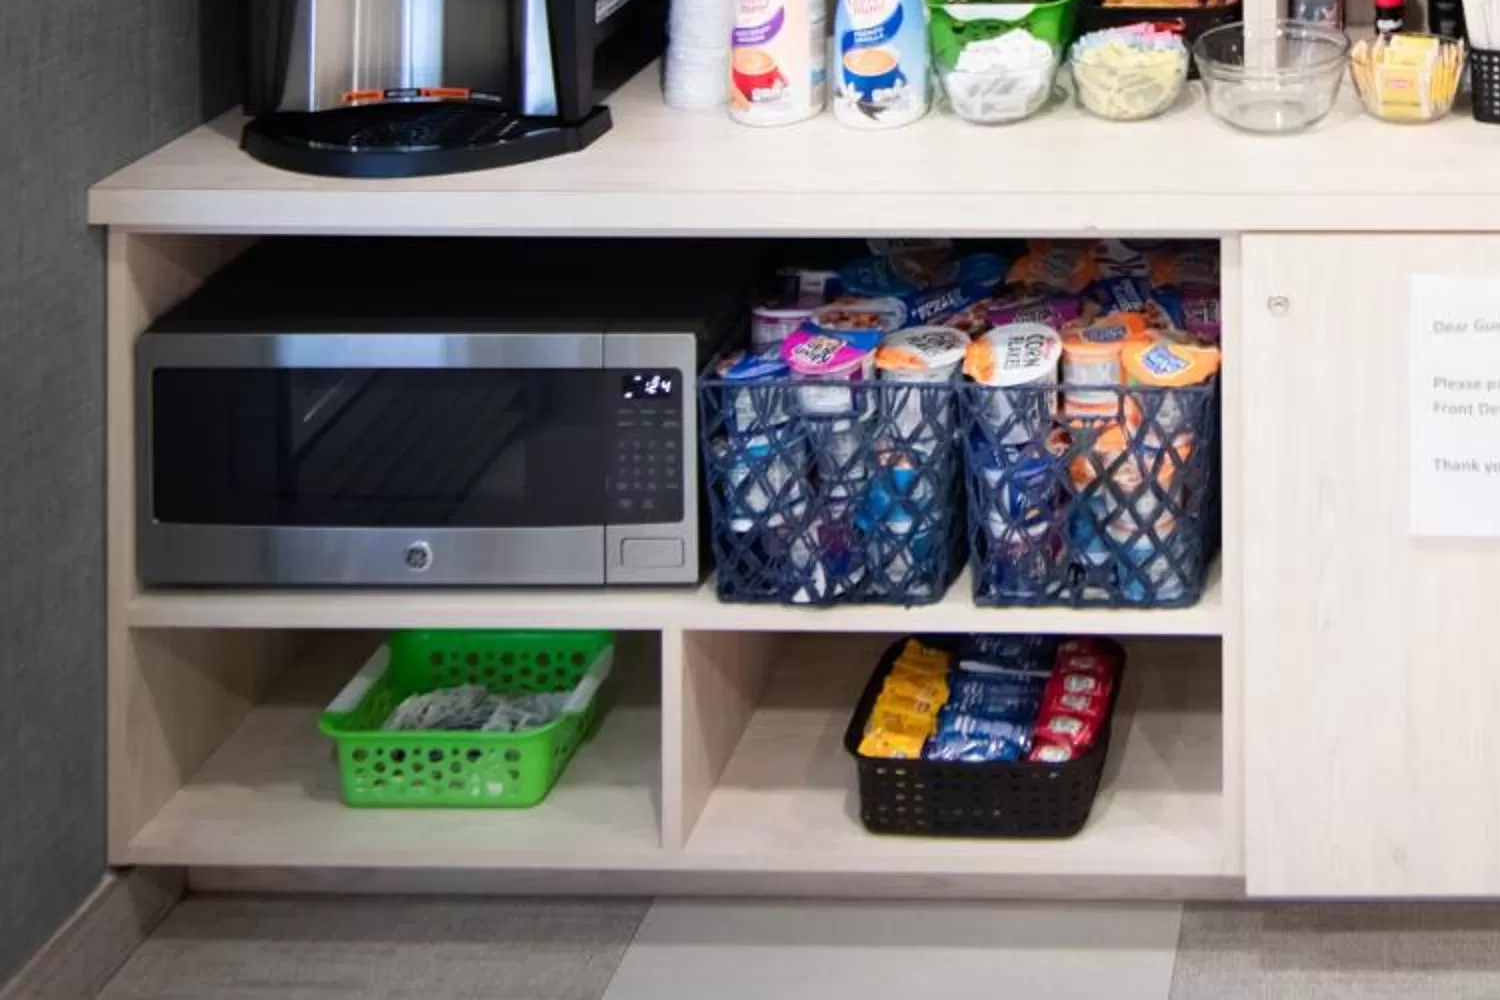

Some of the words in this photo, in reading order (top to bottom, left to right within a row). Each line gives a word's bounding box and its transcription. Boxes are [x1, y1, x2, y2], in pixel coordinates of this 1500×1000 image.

[1432, 319, 1469, 333] Dear
[1432, 376, 1482, 391] Please
[1432, 400, 1474, 417] Front
[1433, 457, 1481, 473] Thank
